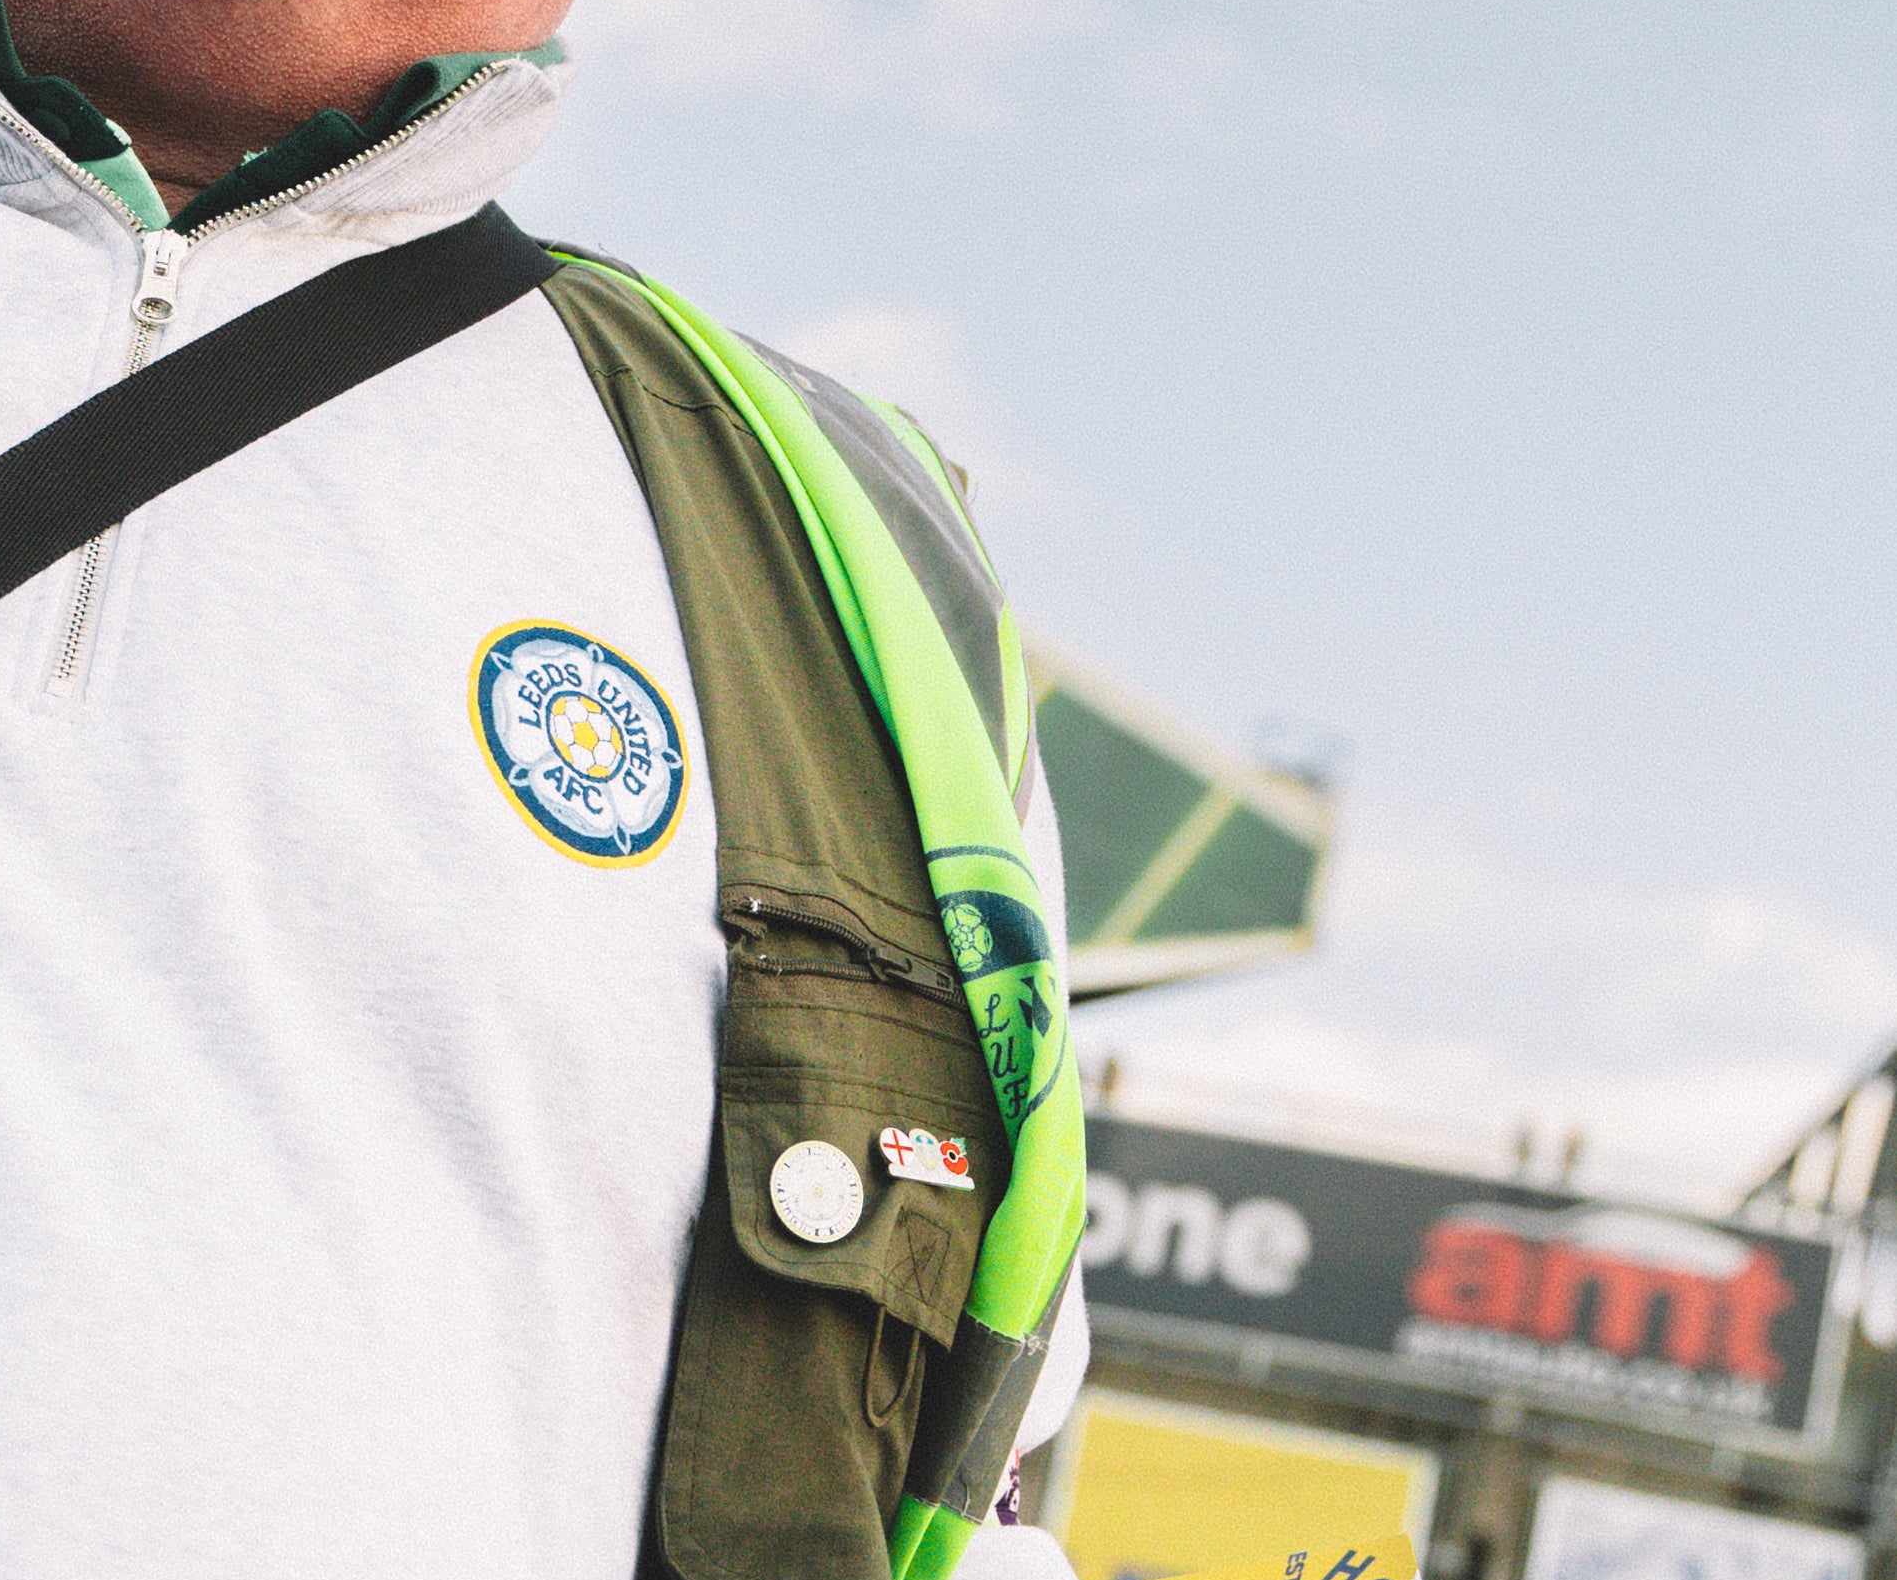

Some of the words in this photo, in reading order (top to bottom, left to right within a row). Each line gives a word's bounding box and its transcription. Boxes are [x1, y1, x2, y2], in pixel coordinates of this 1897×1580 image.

[519, 663, 583, 729] LEEDS
[597, 679, 653, 796] UNITED
[544, 766, 604, 814] AFC
[1406, 1218, 1793, 1382] amt
